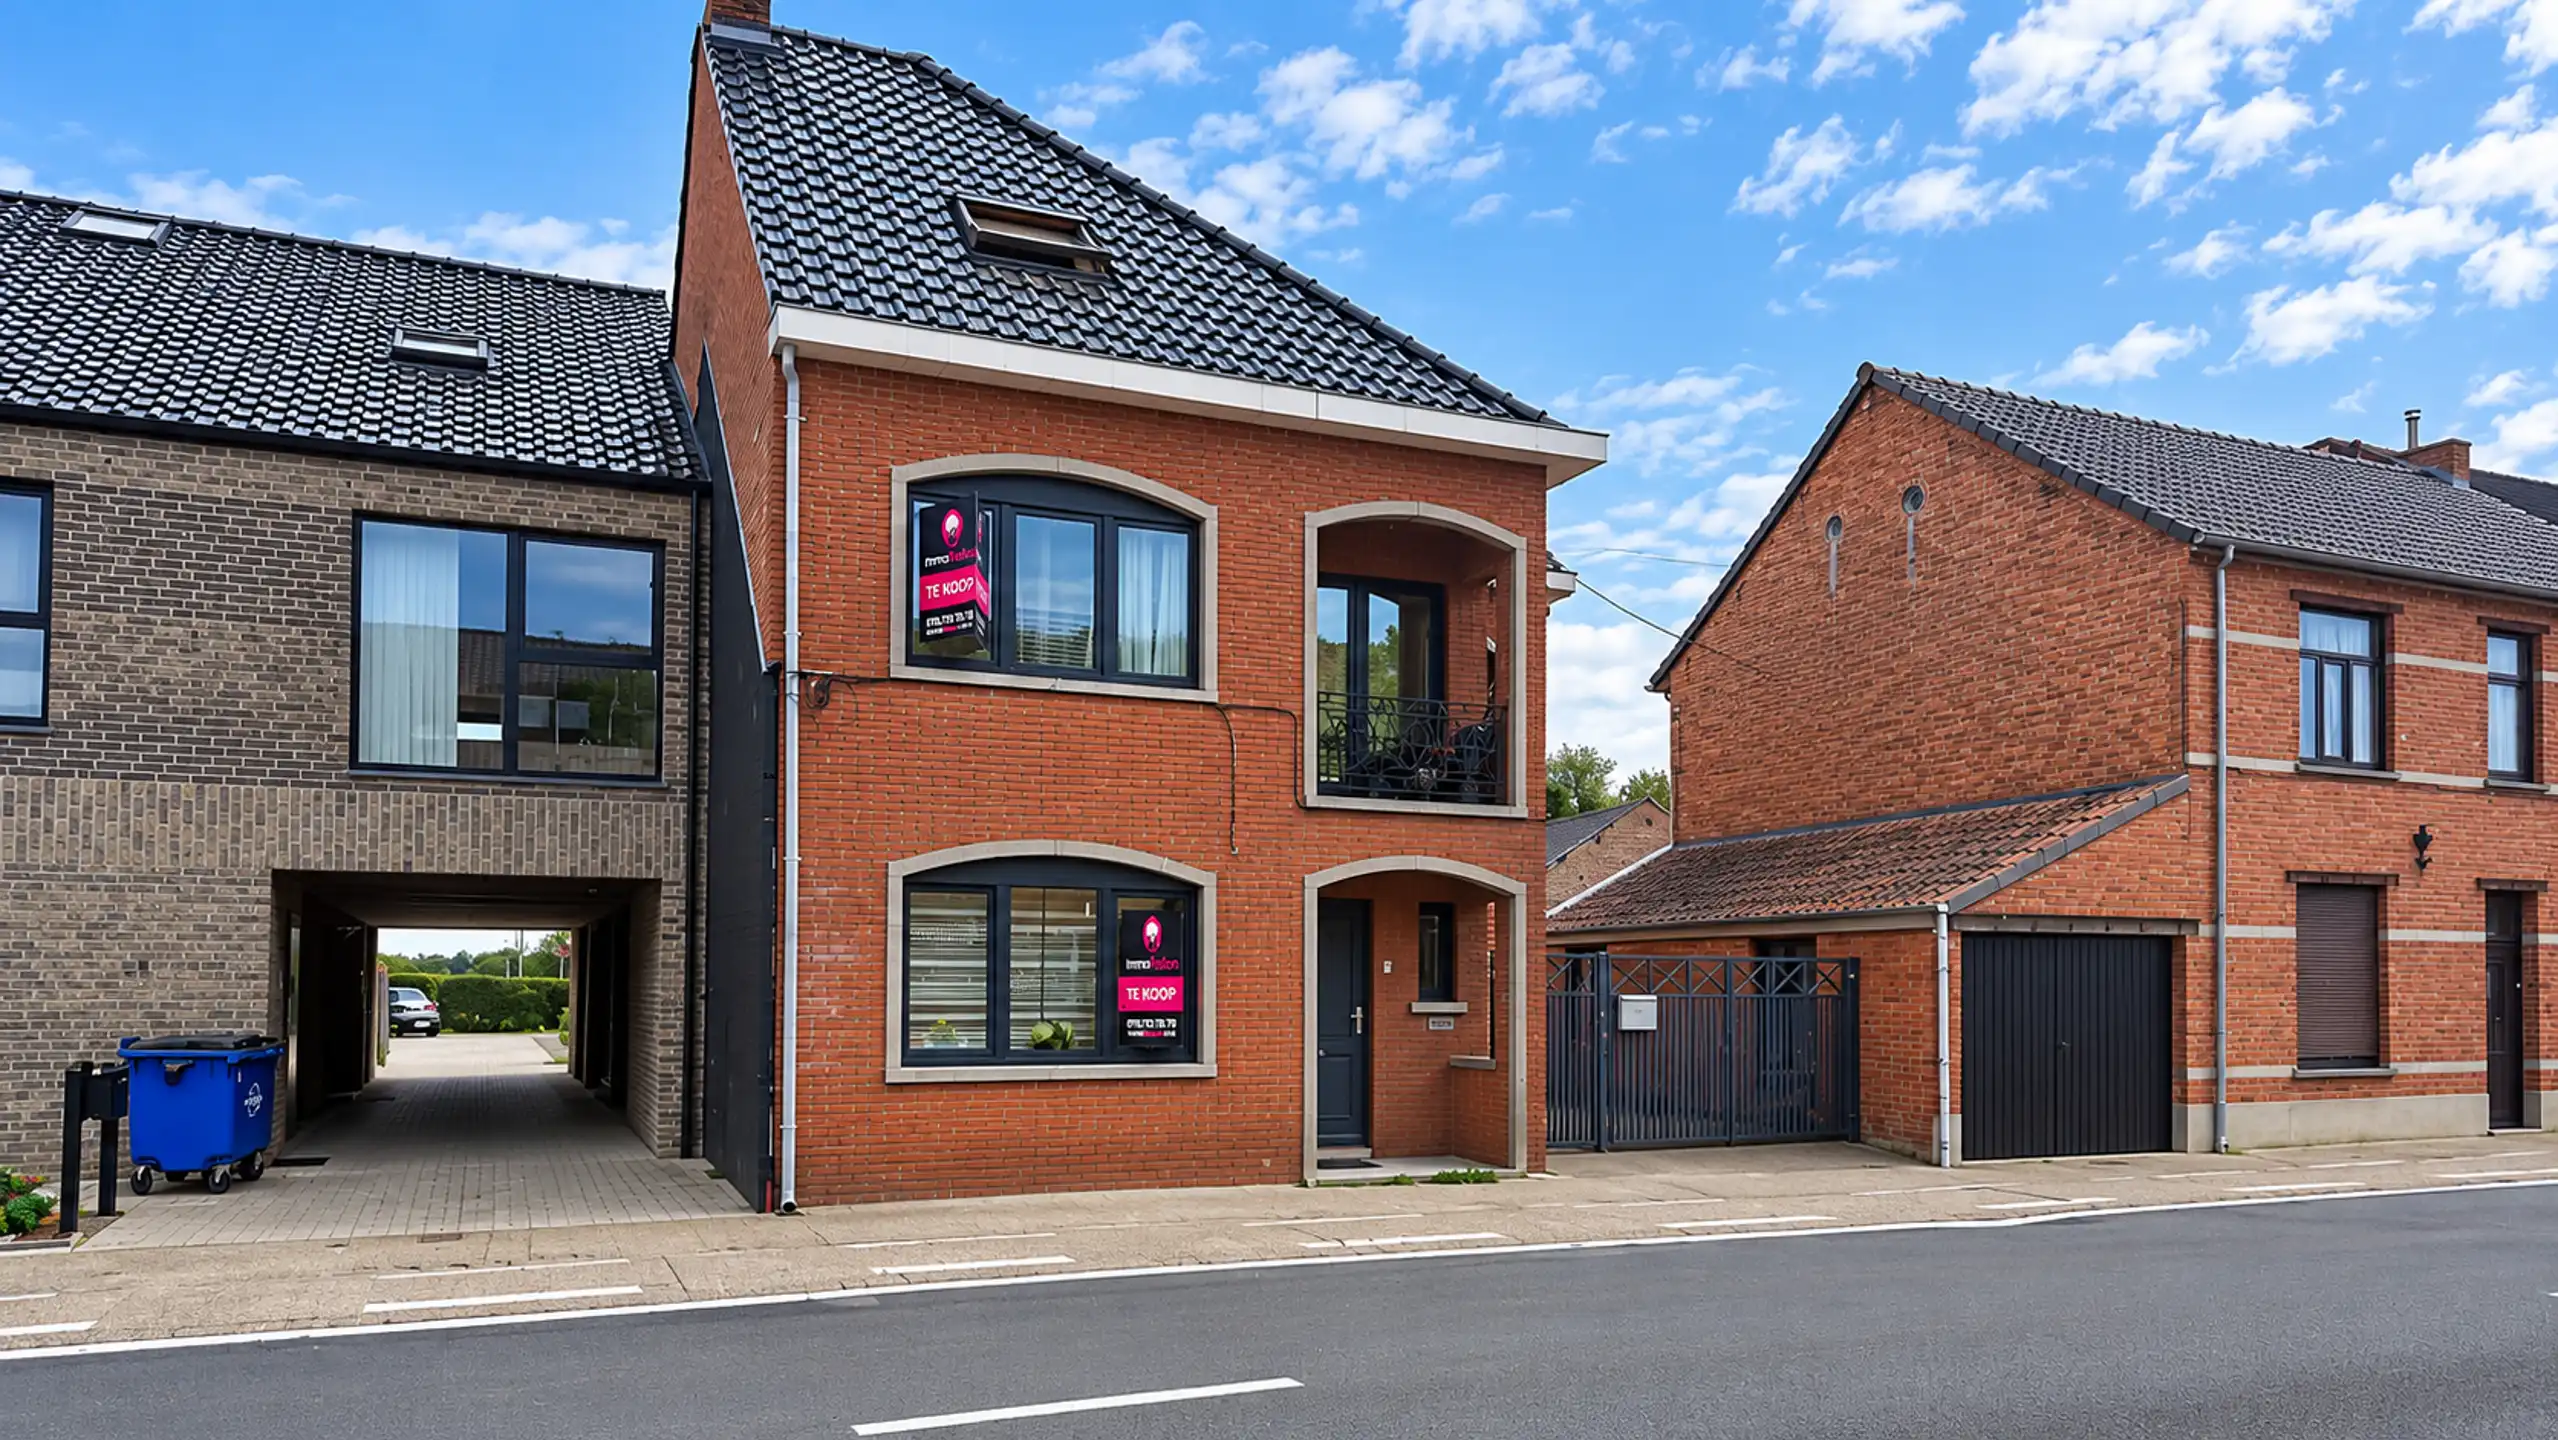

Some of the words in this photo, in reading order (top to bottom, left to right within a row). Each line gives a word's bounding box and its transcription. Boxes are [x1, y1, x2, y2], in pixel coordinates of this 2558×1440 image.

[926, 584, 940, 599] TE
[1126, 987, 1140, 1001] TE
[1142, 987, 1177, 1001] KOOP
